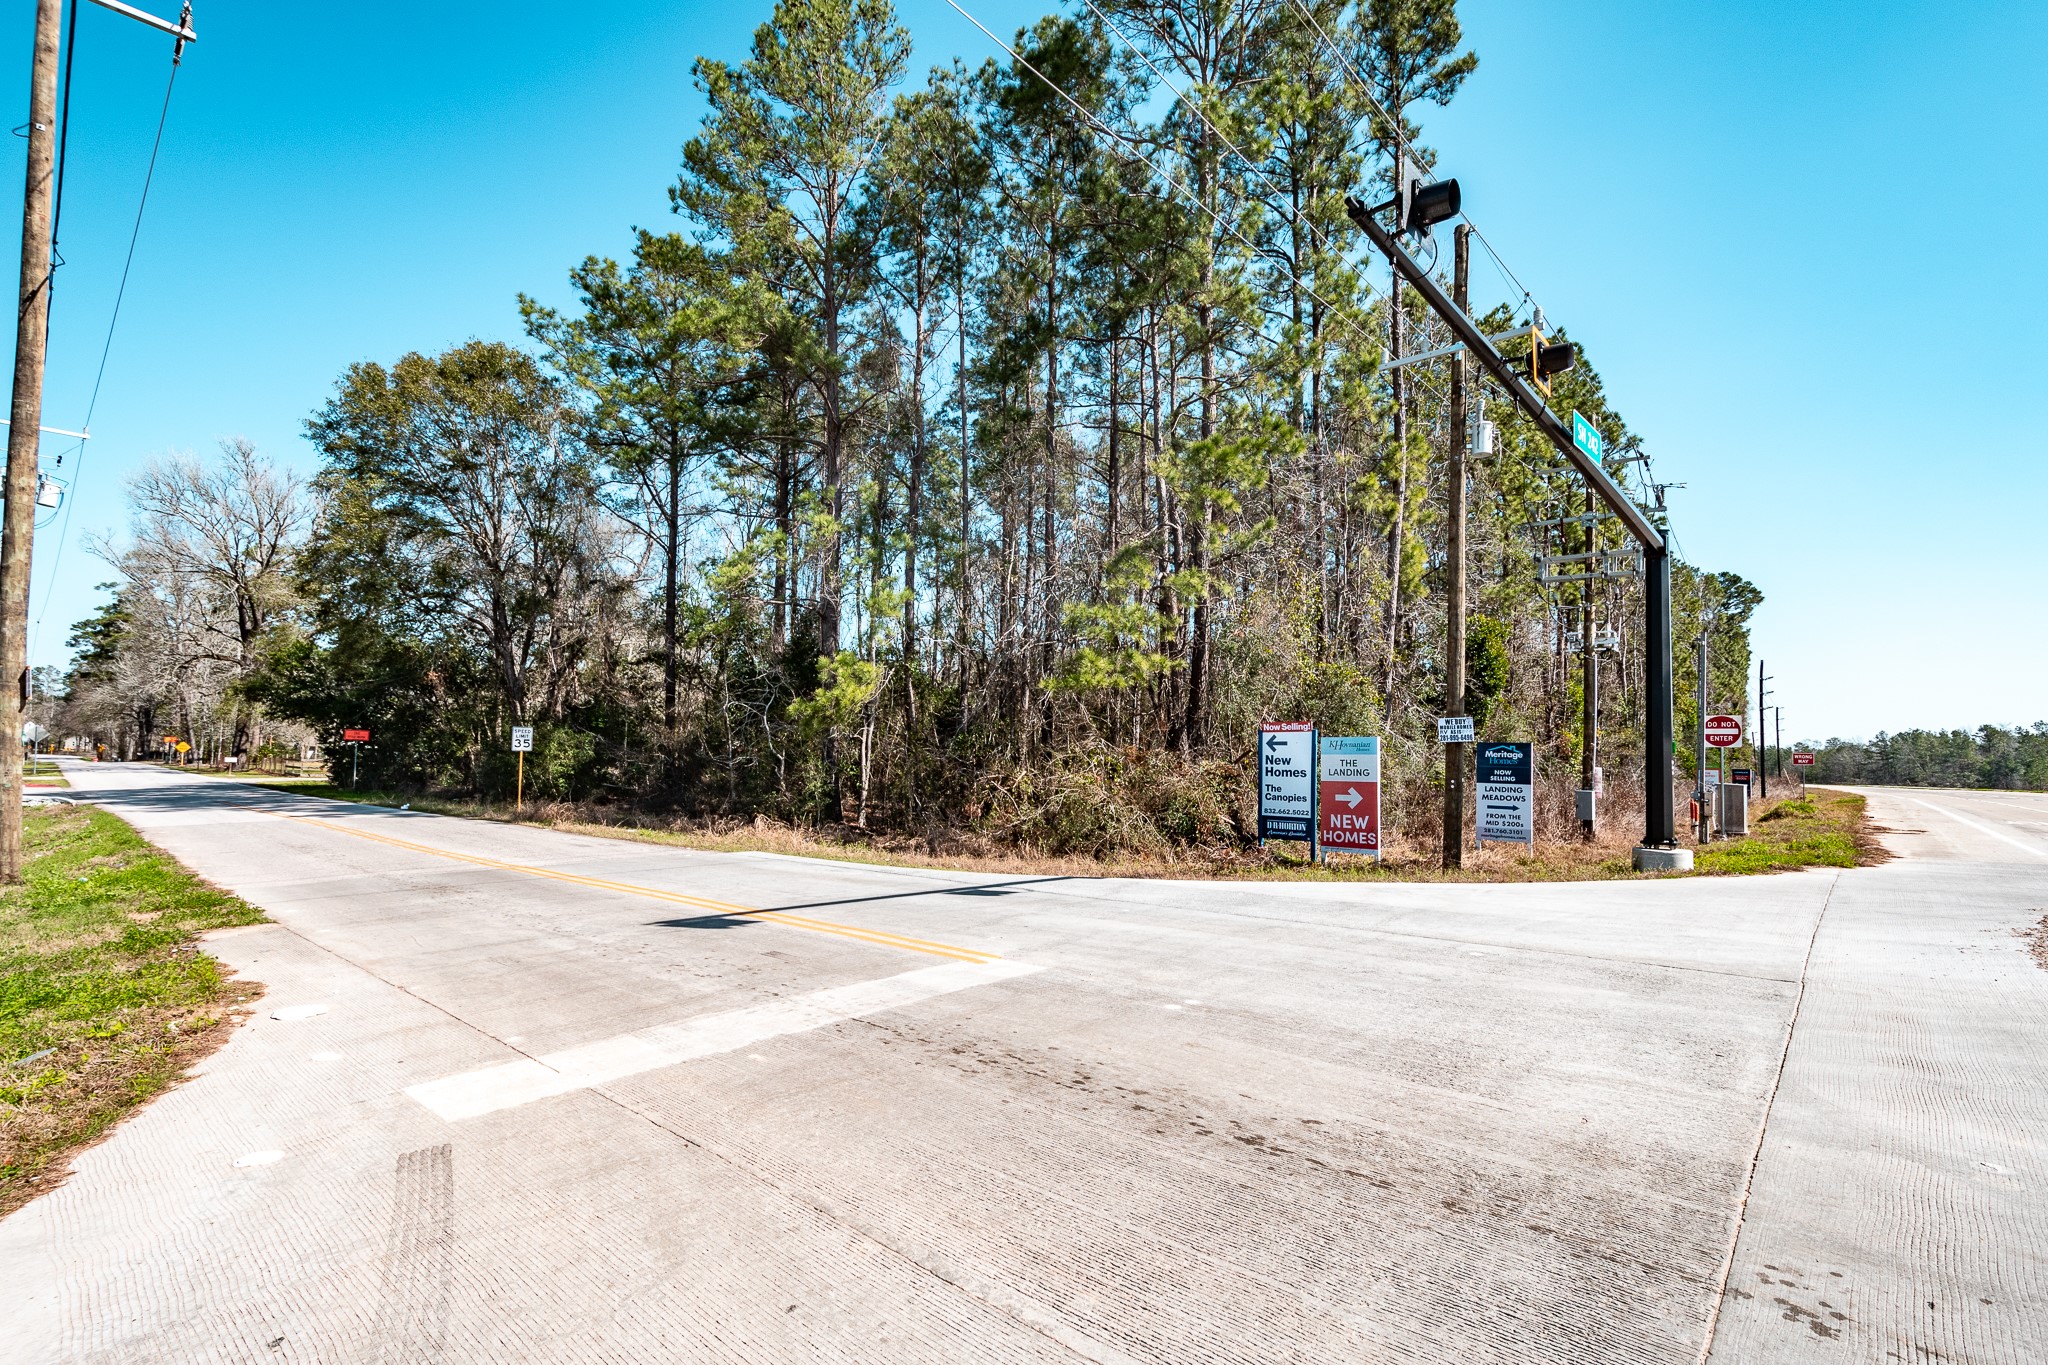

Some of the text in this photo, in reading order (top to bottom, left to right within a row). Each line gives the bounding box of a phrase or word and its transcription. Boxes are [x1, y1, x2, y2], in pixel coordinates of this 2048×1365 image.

[1578, 422, 1599, 456] SH 242
[1263, 722, 1311, 731] Now Selling!
[514, 739, 530, 748] 35
[1265, 755, 1291, 765] New
[1485, 751, 1523, 759] Meritage
[1265, 766, 1307, 778] Homes
[1265, 784, 1282, 792] The
[1265, 793, 1307, 803] Canopies
[1330, 814, 1369, 829] NEW
[1323, 830, 1376, 845] HOMES
